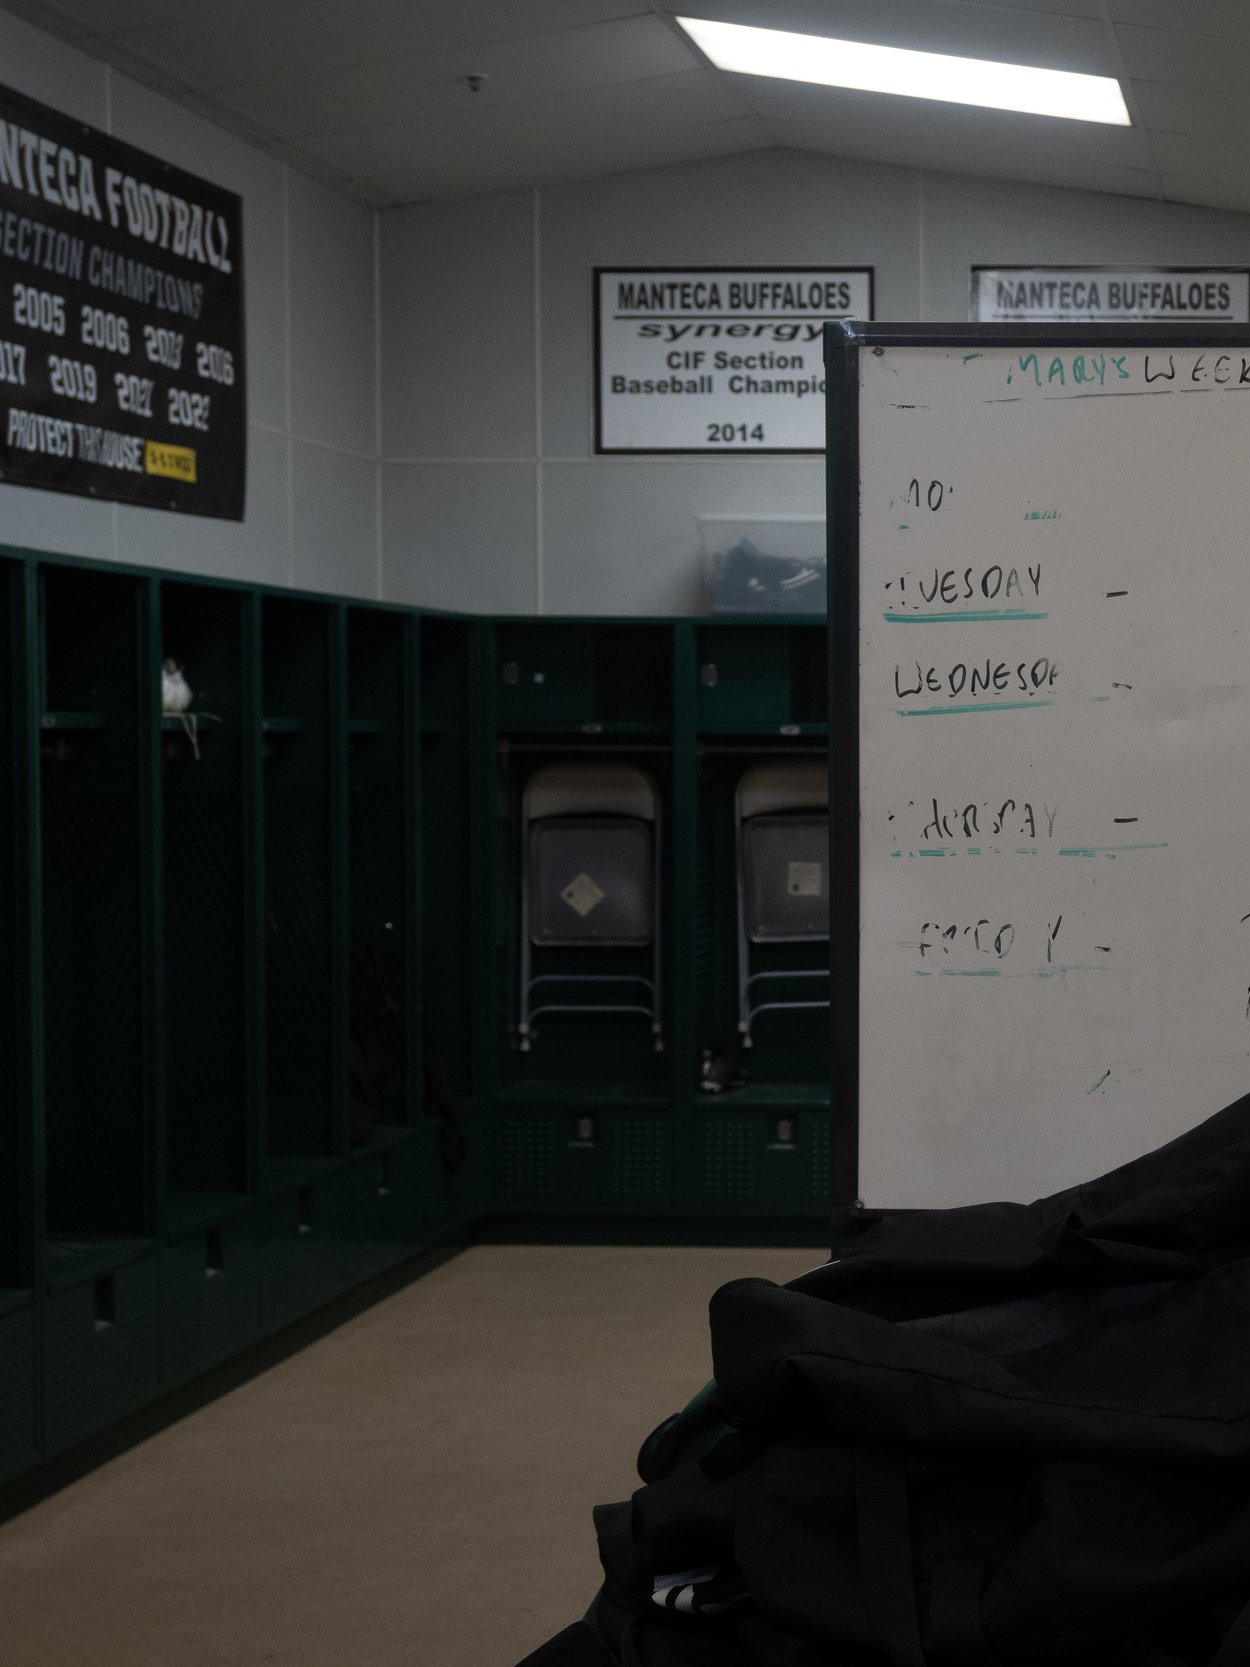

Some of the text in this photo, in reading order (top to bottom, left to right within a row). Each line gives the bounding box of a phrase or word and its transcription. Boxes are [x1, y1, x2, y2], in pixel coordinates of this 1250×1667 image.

[105, 166, 232, 275] FOOTBALL
[0, 208, 203, 320] ECTION CHAMPIONS
[618, 280, 851, 311] MANTECA BUFFALOES
[996, 281, 1231, 311] MANTECA BUFFALOES
[14, 283, 66, 336] 2005
[82, 305, 130, 355] 2006
[637, 321, 825, 342] synergy
[666, 350, 804, 370] CIF Section
[48, 354, 97, 404] 2019
[611, 375, 713, 395] Baseball
[7, 407, 73, 459] PROTECT
[706, 423, 765, 443] 2014
